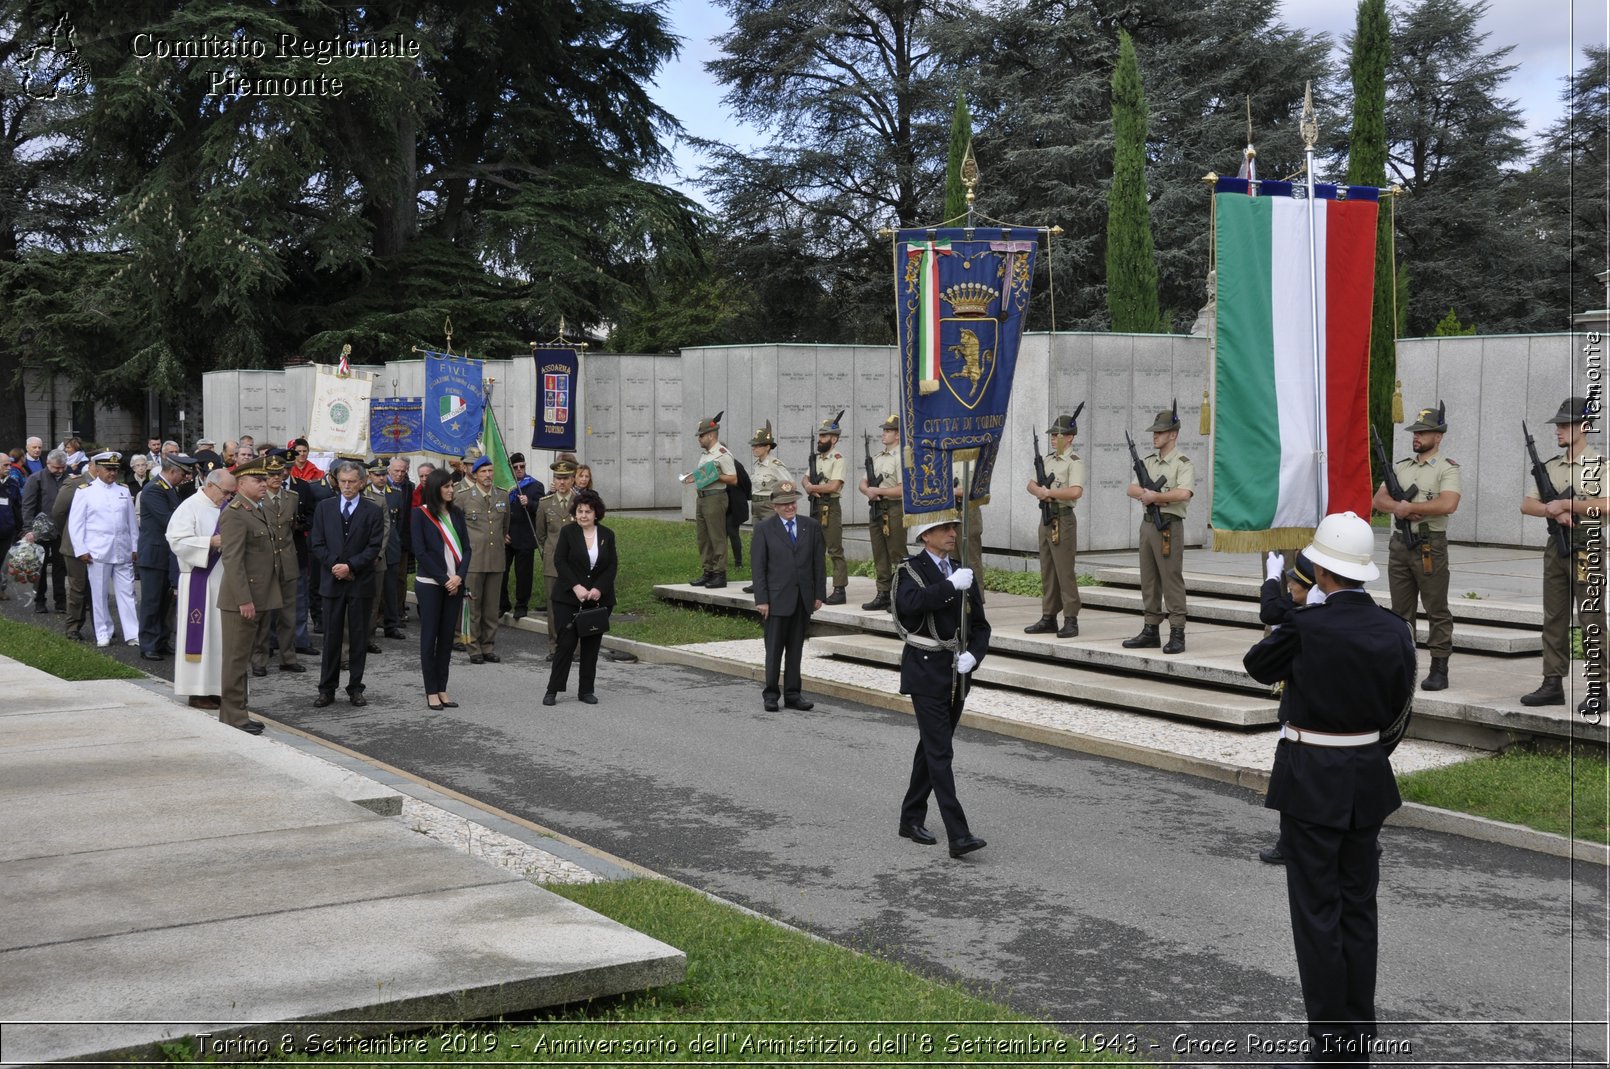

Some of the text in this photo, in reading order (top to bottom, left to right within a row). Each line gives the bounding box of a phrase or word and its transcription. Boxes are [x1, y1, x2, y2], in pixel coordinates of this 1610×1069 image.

[541, 364, 571, 374] ASSOARMA
[963, 417, 972, 430] DI
[976, 414, 1004, 429] TORINO
[545, 425, 564, 434] TORINO
